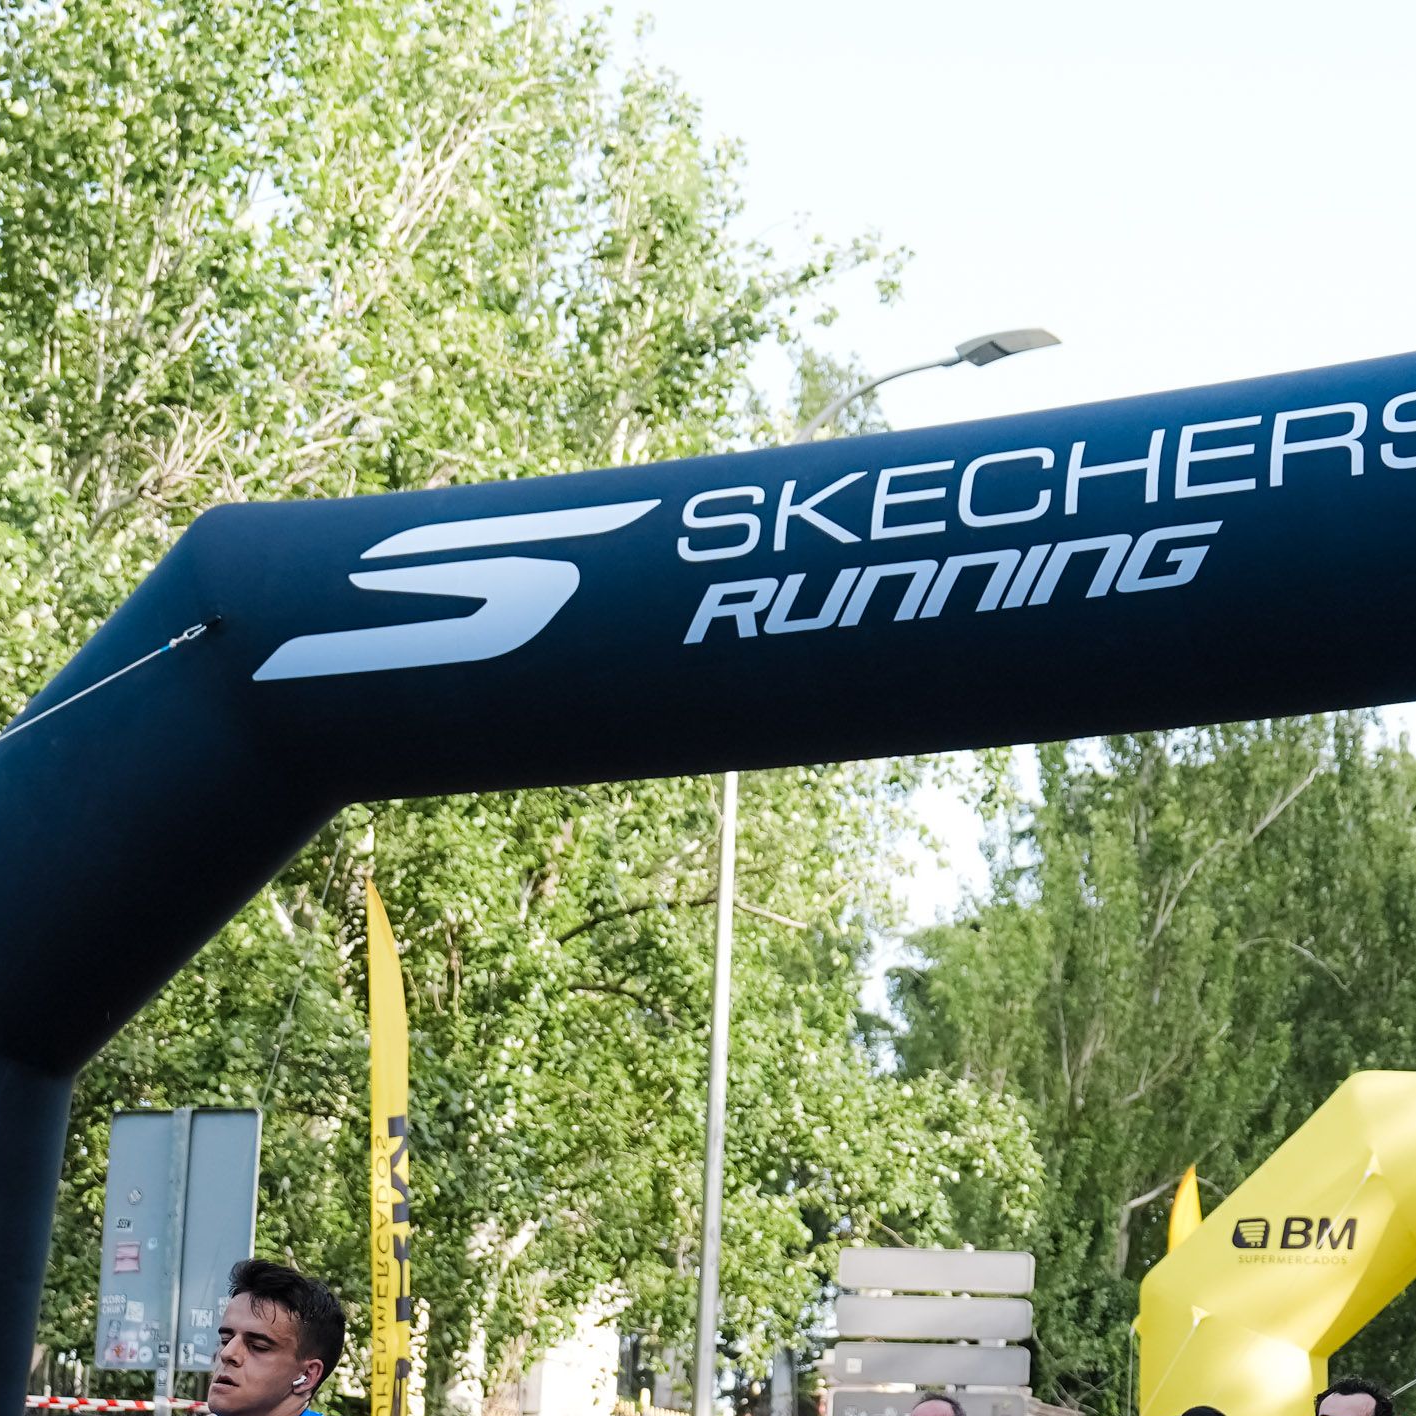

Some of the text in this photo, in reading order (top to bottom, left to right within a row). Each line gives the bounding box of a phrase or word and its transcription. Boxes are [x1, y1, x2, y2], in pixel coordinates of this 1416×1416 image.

[683, 521, 1223, 645] RUNNING
[1280, 1216, 1357, 1250] BM
[1238, 1254, 1348, 1266] SUPERMERCADOS
